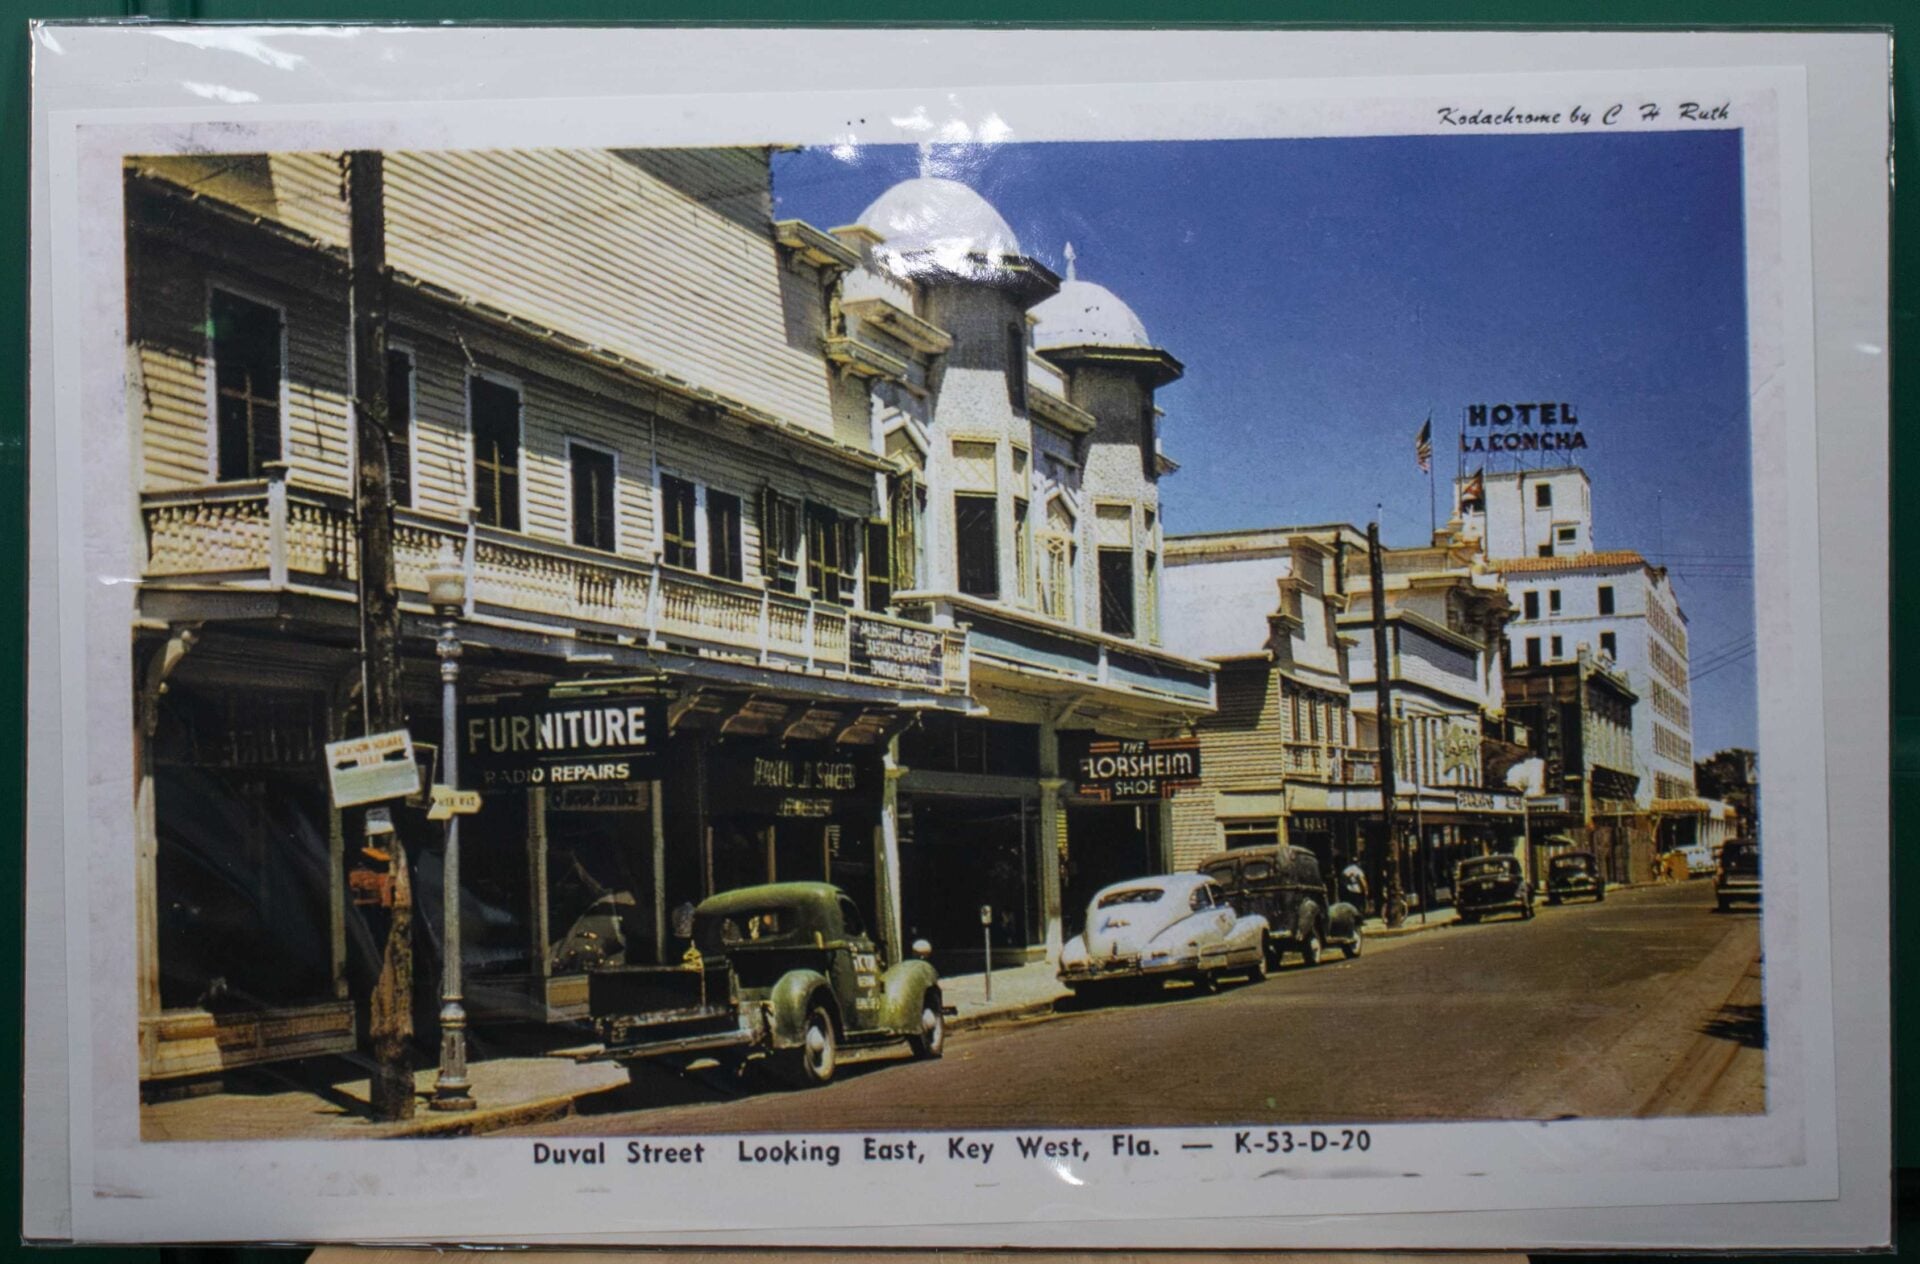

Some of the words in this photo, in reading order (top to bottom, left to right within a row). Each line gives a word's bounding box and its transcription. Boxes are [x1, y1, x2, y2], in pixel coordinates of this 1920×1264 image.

[1437, 106, 1561, 126] Kodachrome
[1570, 105, 1592, 125] by
[1602, 104, 1623, 125] C
[1639, 103, 1660, 120] H
[1679, 102, 1730, 121] Ruth
[1469, 403, 1578, 426] HOTEL
[1488, 431, 1587, 451] CONCHA
[468, 706, 647, 753] FURNITURE
[1122, 742, 1145, 754] THE
[485, 767, 544, 783] RADIO
[551, 763, 630, 782] REPAIRS
[533, 1141, 605, 1165] Duval
[627, 1141, 705, 1164] Street
[738, 1139, 840, 1167] Looking
[863, 1137, 925, 1164] East,
[948, 1137, 994, 1164] Key
[1016, 1136, 1089, 1162] West,
[1112, 1134, 1159, 1156] Fla.
